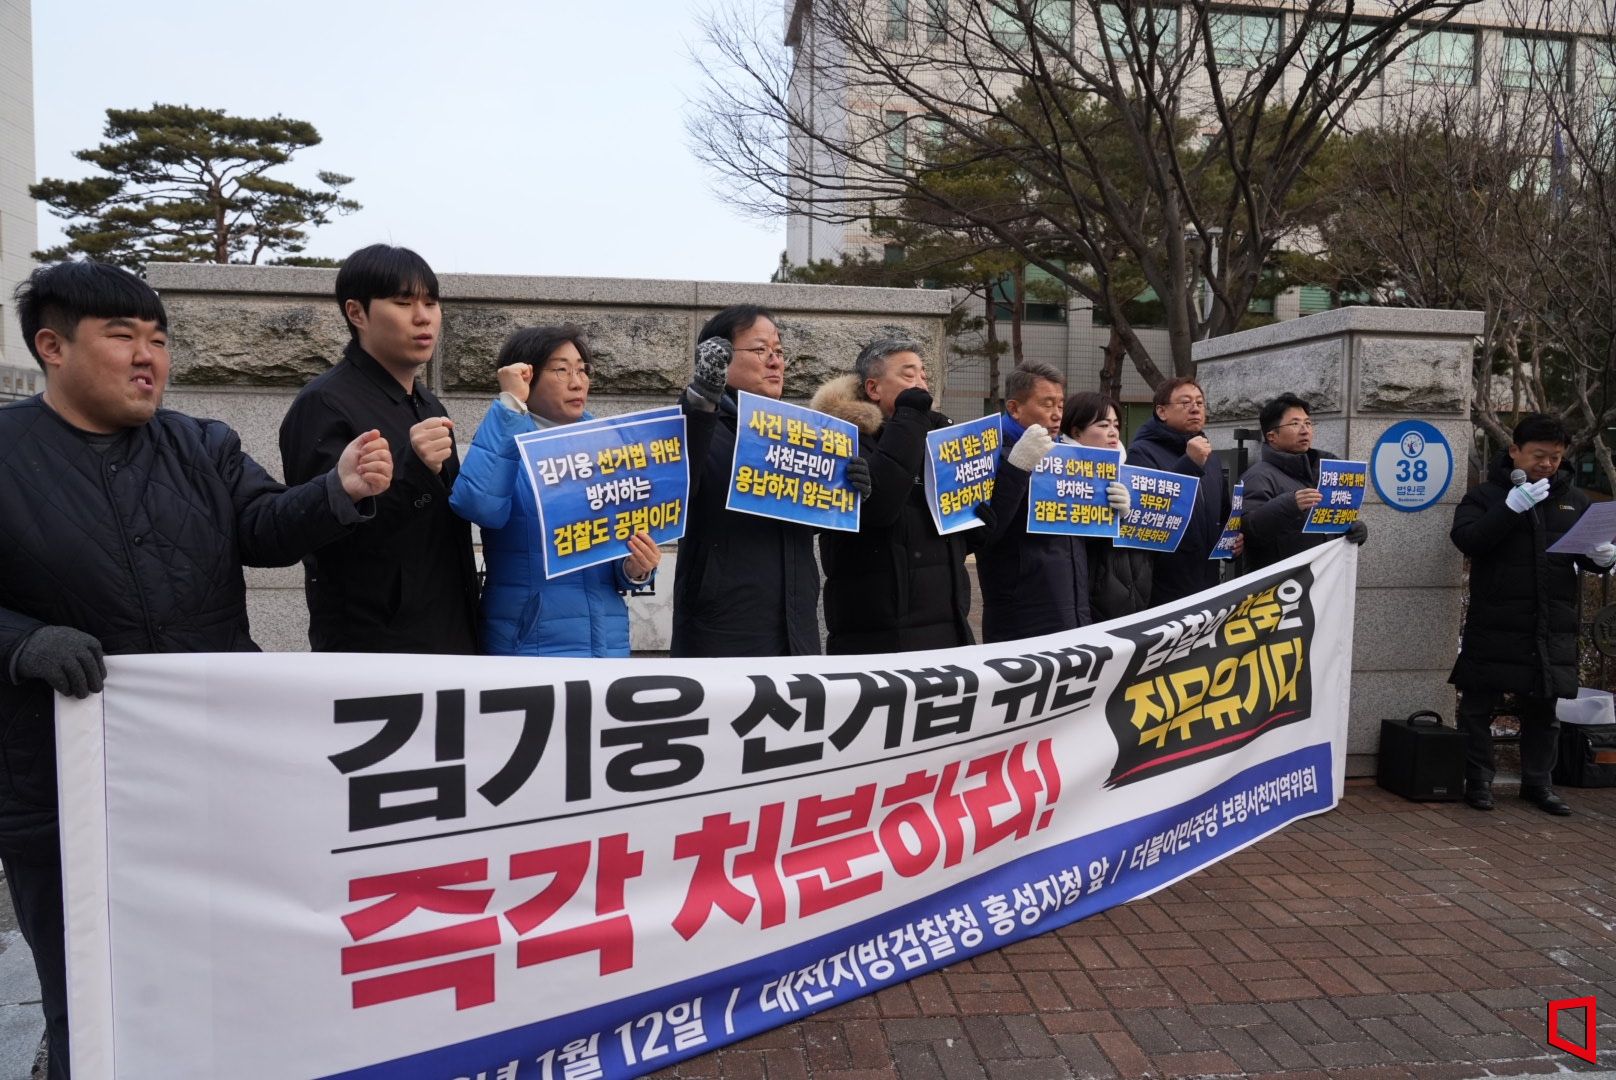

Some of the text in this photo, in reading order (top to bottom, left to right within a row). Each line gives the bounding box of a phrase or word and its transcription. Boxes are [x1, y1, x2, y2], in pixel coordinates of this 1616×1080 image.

[748, 410, 853, 457] 사건 덮는 검찰!
[939, 428, 999, 463] 사건 덮는 검찰!
[537, 436, 681, 485] 김기웅 선거법 위반
[764, 444, 835, 481] 서천군민이
[955, 453, 995, 484] 서천군민이
[1065, 459, 1093, 478] 선거법
[1096, 462, 1116, 480] 위반
[1396, 459, 1428, 482] 38
[585, 476, 652, 511] 방치하는
[735, 466, 854, 512] 용납하지 않는다!
[1057, 480, 1094, 500] 방치하는
[1131, 475, 1181, 497] 검찰의 침묵은
[1322, 471, 1338, 487] 김기웅
[1396, 485, 1426, 496] 법원로
[940, 482, 982, 515] 용납하지
[1034, 501, 1114, 526] 검찰도 공범이다
[1140, 493, 1171, 512] 직무유기
[553, 499, 682, 558] 검찰도 공범이다
[1135, 527, 1170, 543] 처분하라!
[1141, 511, 1166, 528] 선거법
[1166, 515, 1182, 530] 위반
[1124, 637, 1304, 748] 직무유기다
[327, 643, 1114, 832] 김기웅 선거법 위반
[340, 737, 1061, 1011] 즉각 처분하라!
[614, 996, 708, 1066] 12일
[759, 903, 984, 1013] 대전지방검찰청
[981, 868, 1083, 938] 홍성지청
[1087, 856, 1111, 894] 앞
[1129, 803, 1218, 871] 더불어민주당
